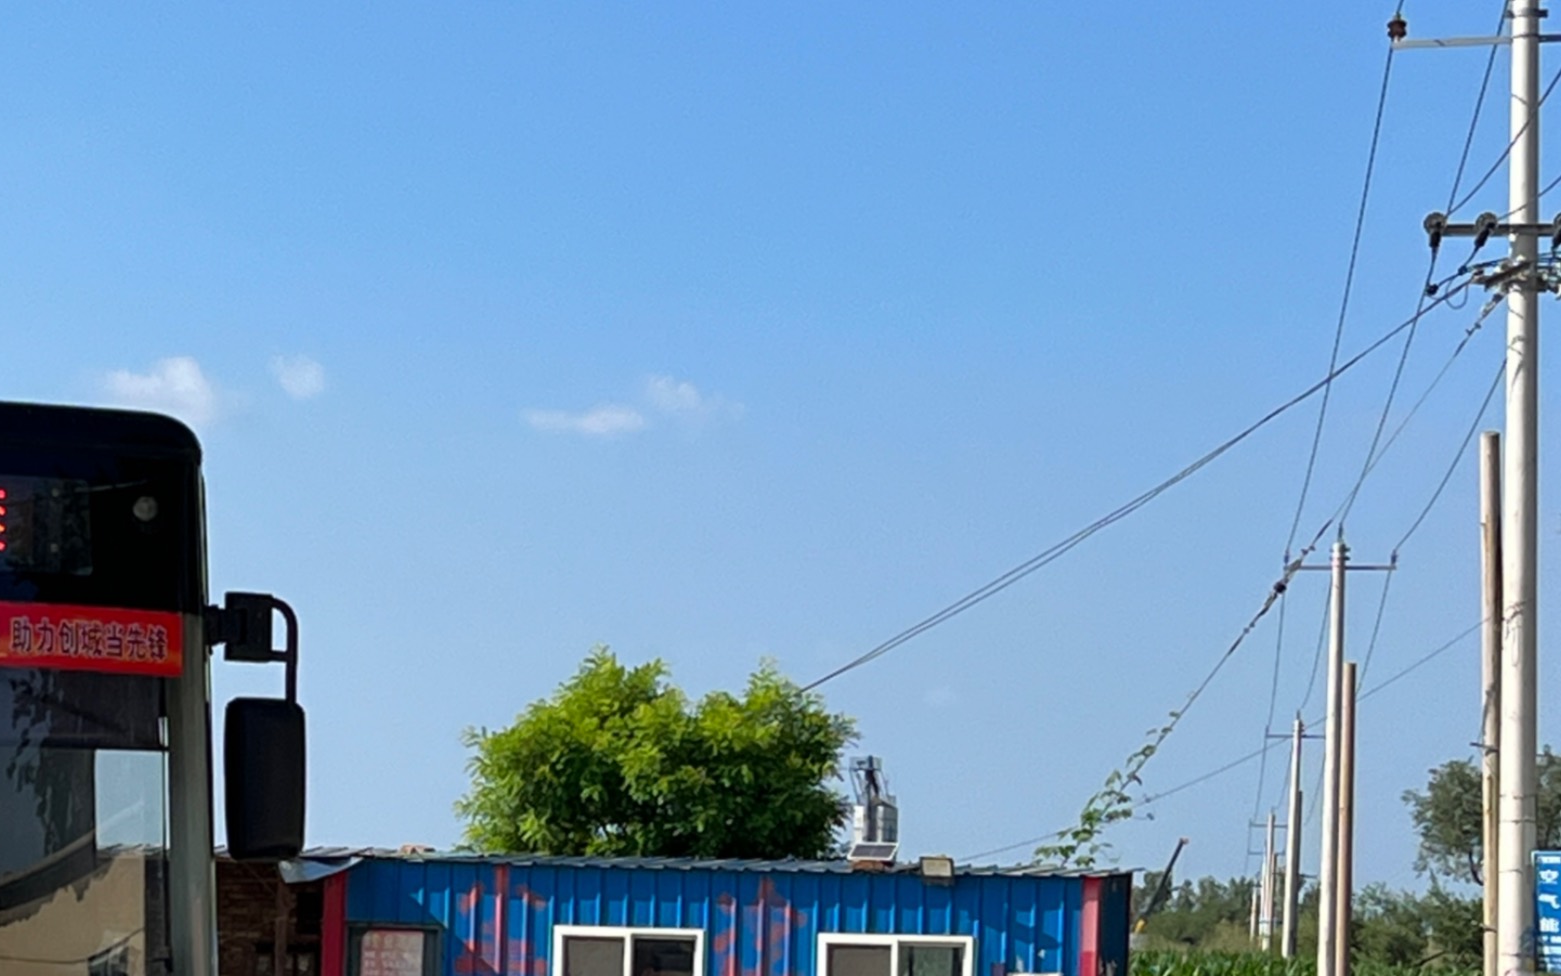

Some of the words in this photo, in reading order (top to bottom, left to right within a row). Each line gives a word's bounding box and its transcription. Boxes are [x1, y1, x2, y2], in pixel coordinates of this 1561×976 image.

[9, 615, 168, 662] 助力创城当先锋
